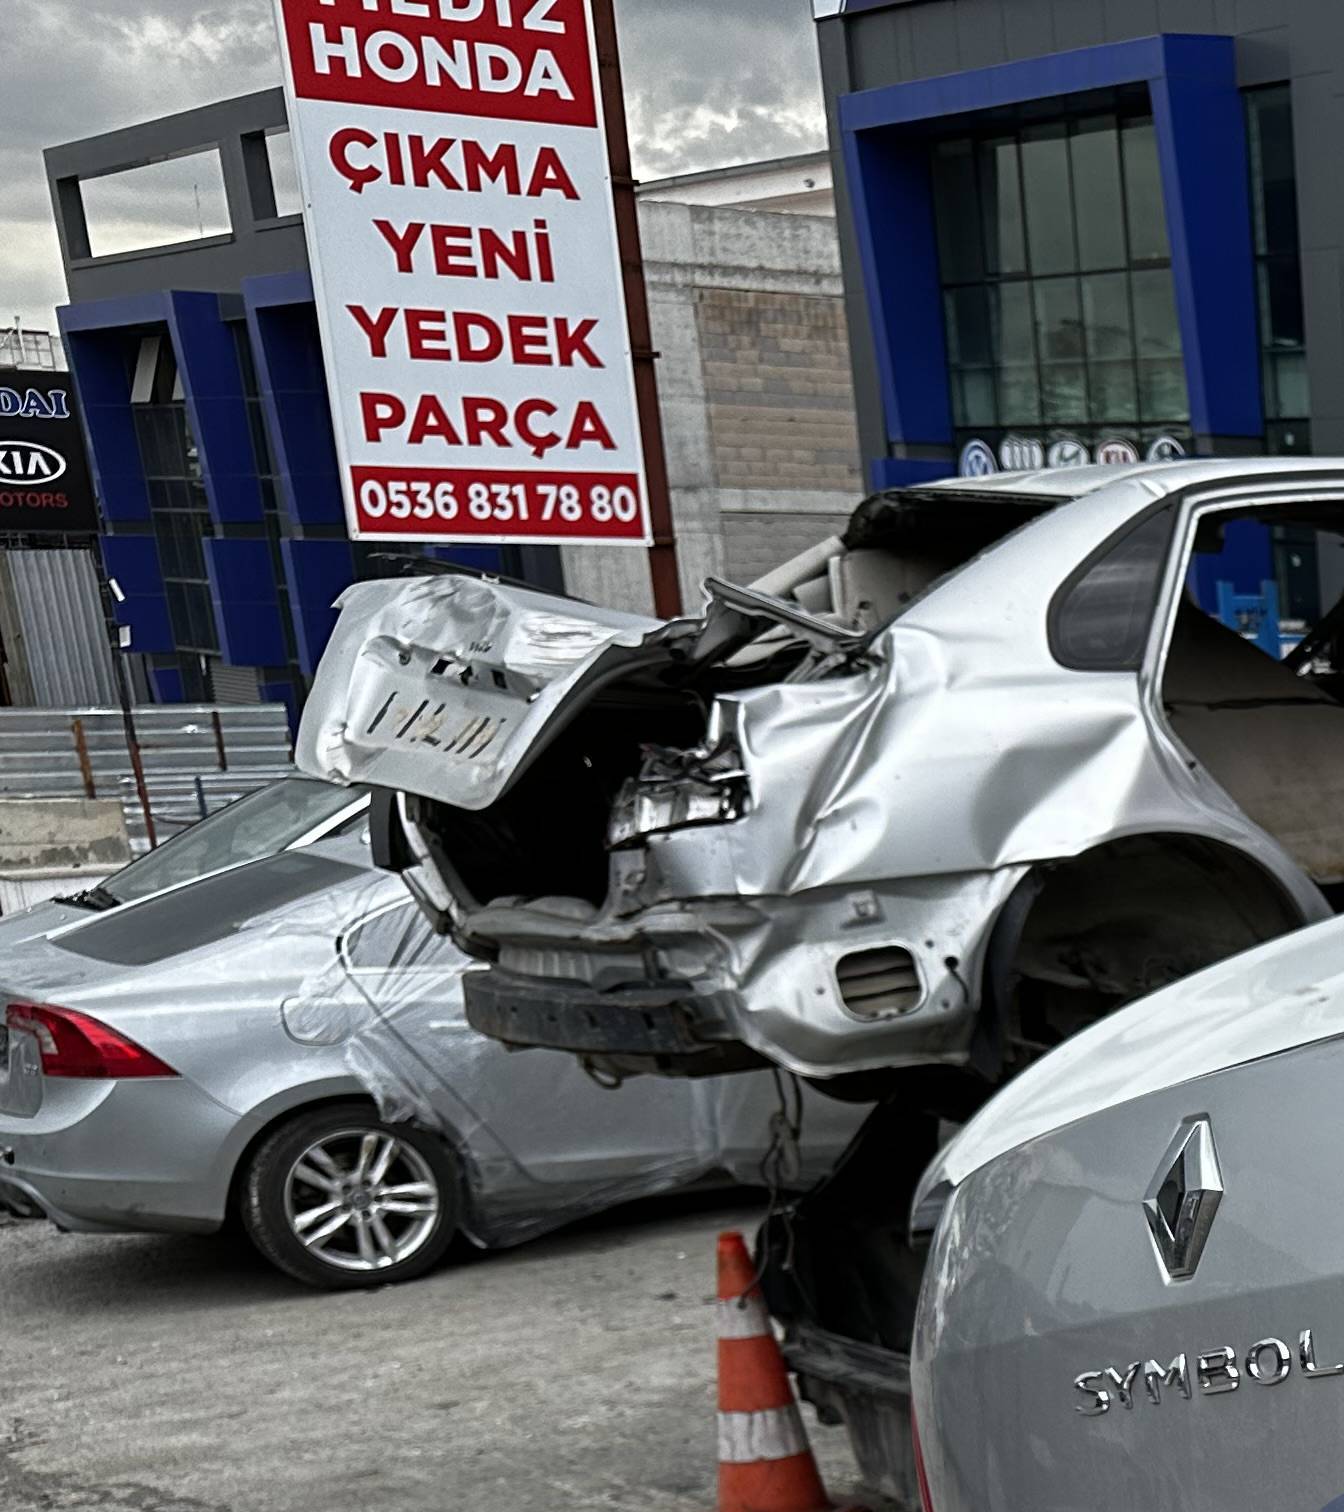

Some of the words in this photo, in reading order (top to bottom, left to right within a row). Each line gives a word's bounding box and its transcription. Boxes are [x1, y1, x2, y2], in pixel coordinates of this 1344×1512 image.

[308, 22, 575, 100] HONDA
[329, 128, 580, 201] ÇIKMA
[373, 218, 554, 283] YENİ
[348, 305, 605, 368] YEDEK
[359, 391, 618, 458] PARÇA
[360, 479, 459, 520] 0536
[467, 482, 529, 521] 831
[536, 484, 582, 521] 78
[590, 485, 638, 522] 80
[1074, 1329, 1344, 1416] SYMBOL
